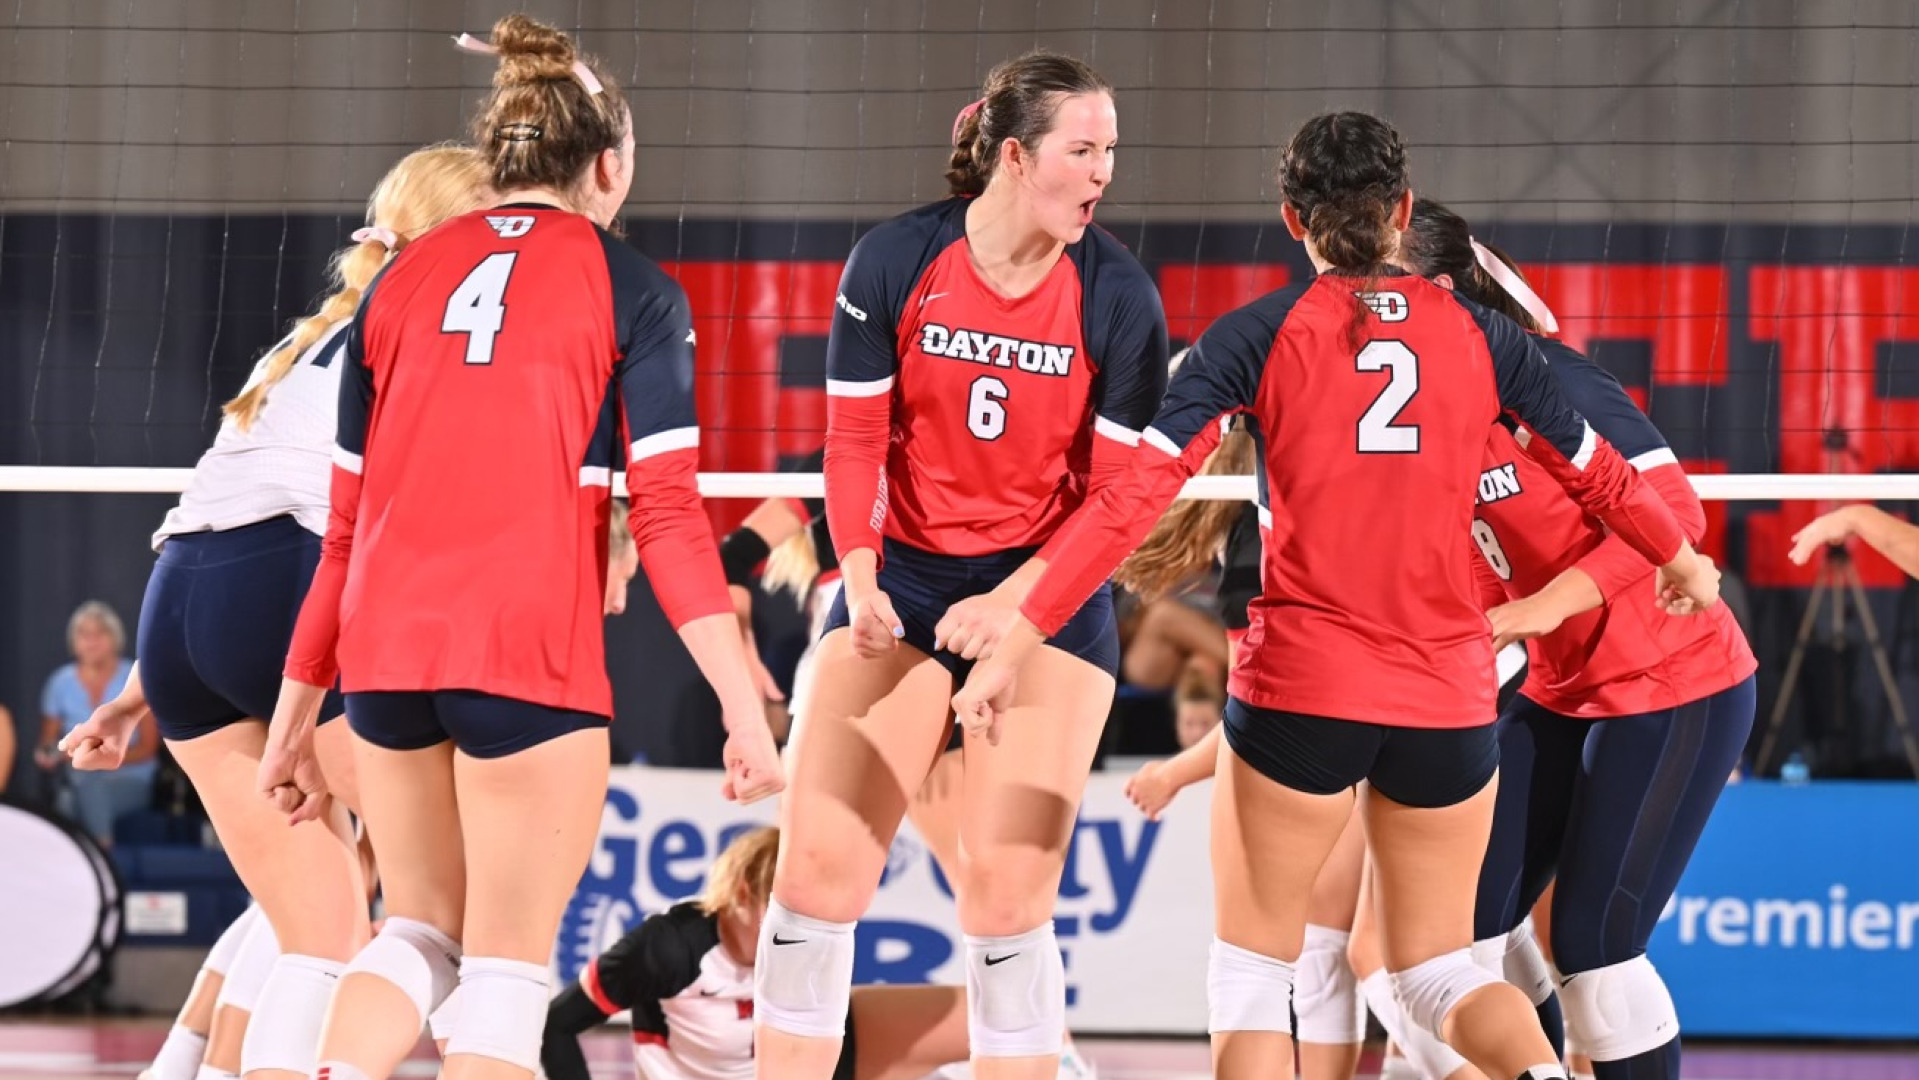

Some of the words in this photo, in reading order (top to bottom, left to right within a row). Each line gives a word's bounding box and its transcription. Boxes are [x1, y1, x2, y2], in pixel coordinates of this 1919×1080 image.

[440, 250, 519, 365] 4
[920, 321, 1076, 377] DAYTON
[966, 374, 1009, 441] 6
[1354, 339, 1420, 454] 2
